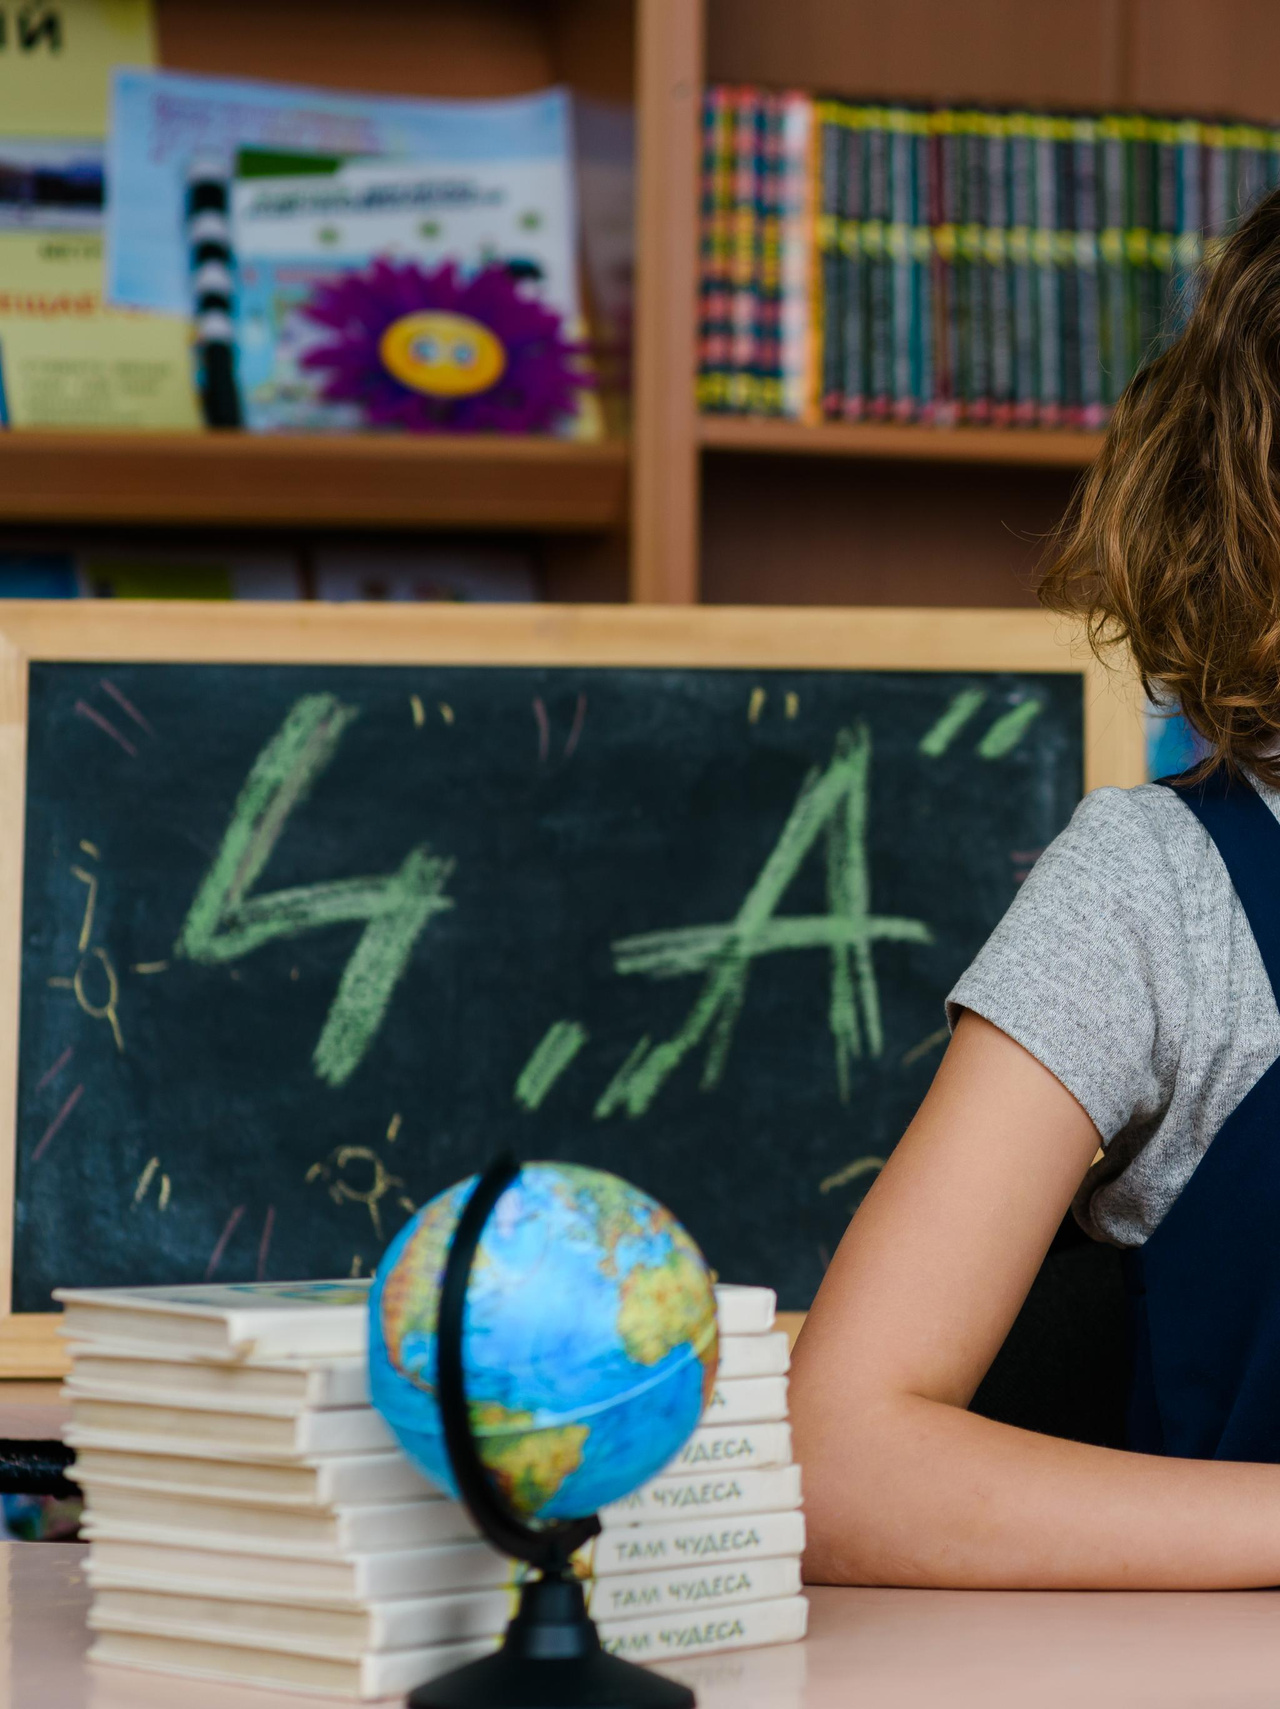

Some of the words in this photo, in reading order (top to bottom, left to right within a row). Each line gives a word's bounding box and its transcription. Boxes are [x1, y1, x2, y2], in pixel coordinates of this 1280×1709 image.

[175, 693, 456, 1087] 4
[651, 1481, 743, 1509] ЧУДЕСА
[615, 1541, 666, 1561] ТАМ
[674, 1529, 760, 1556] ЧУДЕСА
[609, 1587, 658, 1608] ТАМ
[668, 1573, 752, 1602] ЧУДЕСА
[658, 1620, 745, 1648] ЧУДЕСА
